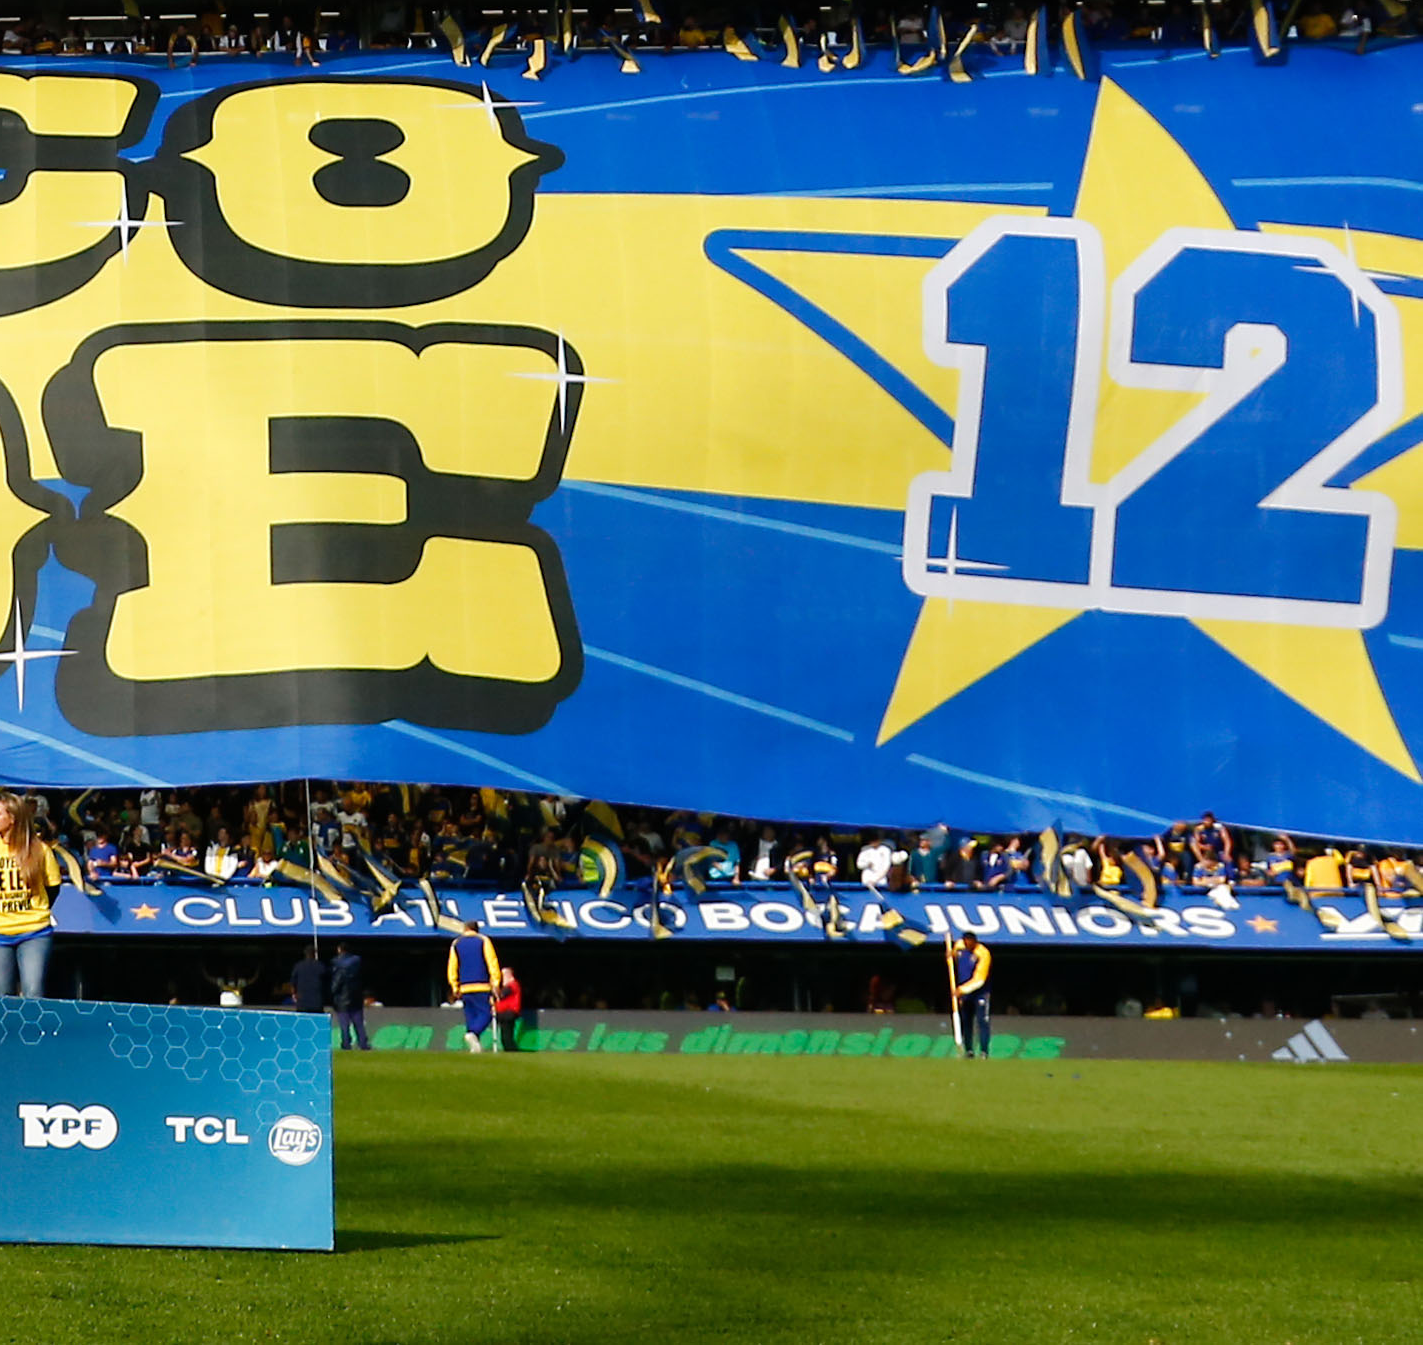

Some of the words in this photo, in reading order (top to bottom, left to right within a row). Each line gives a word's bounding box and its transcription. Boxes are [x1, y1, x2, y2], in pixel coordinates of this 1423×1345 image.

[904, 215, 1403, 629] 12
[172, 896, 352, 926] CLUB
[924, 902, 1237, 938] JUNIORS
[38, 1117, 102, 1135] YPF
[166, 1116, 249, 1144] TCL
